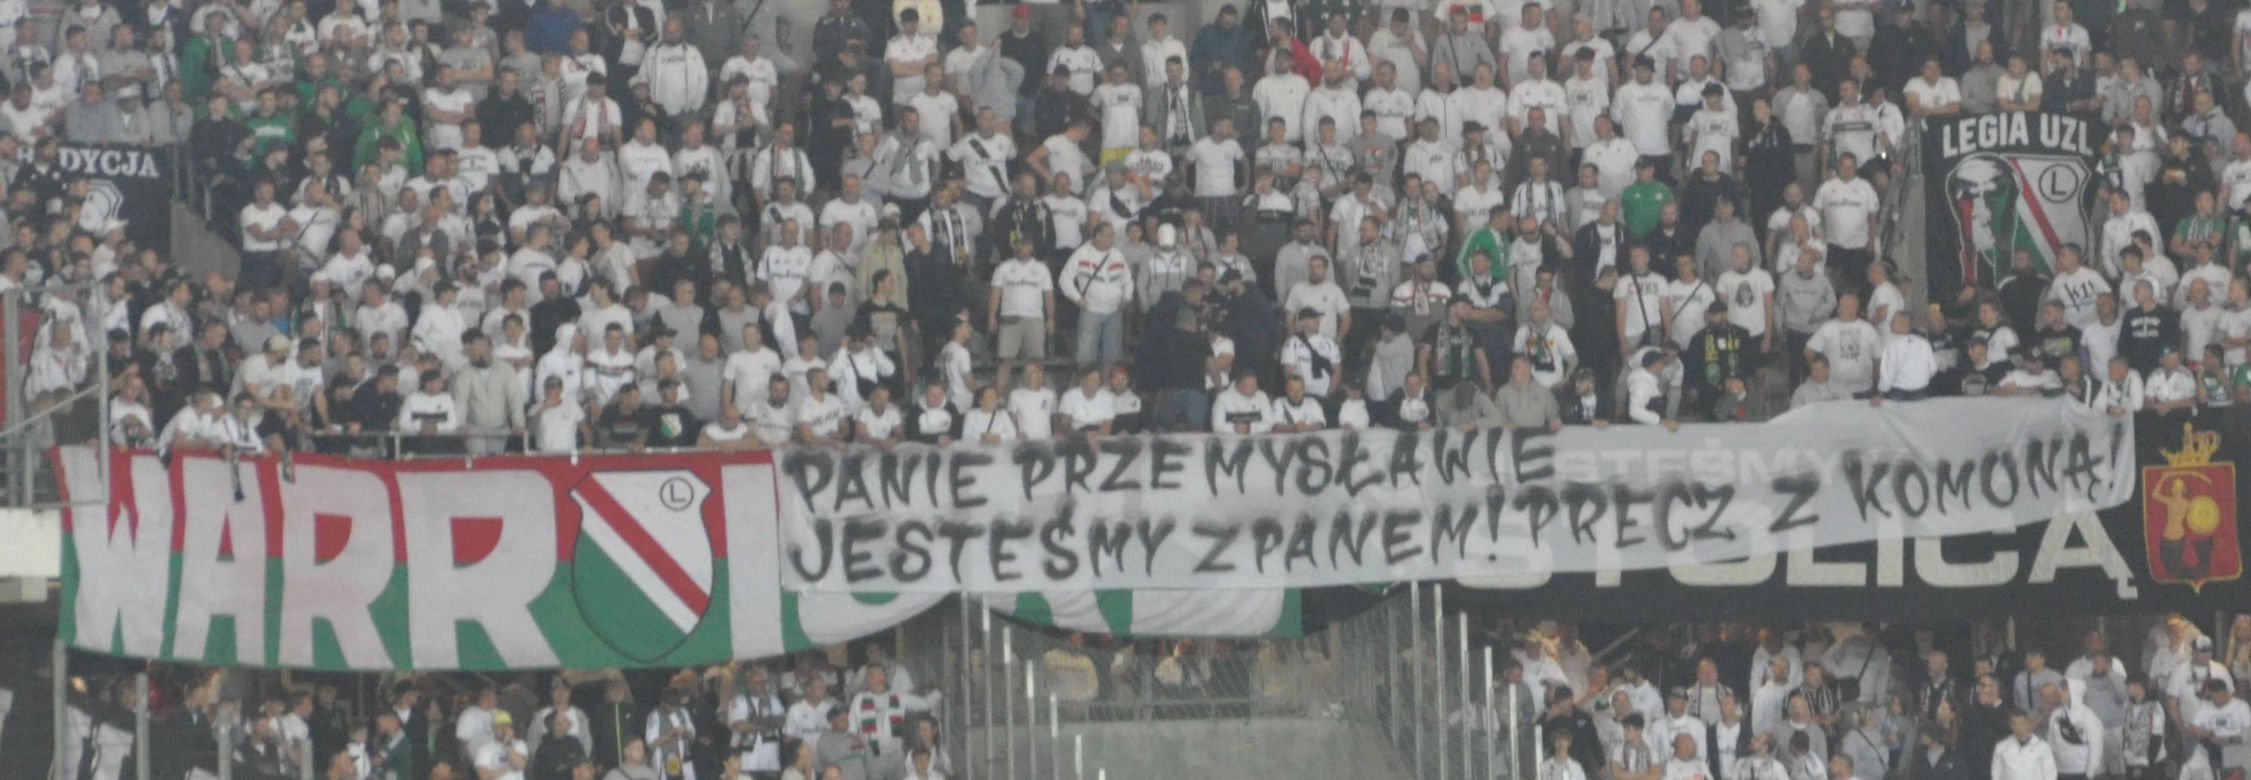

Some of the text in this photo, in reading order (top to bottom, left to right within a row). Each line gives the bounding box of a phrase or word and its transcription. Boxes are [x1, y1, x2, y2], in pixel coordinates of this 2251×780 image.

[1943, 111, 2093, 158] LEGIA UZL
[782, 450, 994, 514] PANIE
[788, 498, 1176, 583] JESTEŚMY
